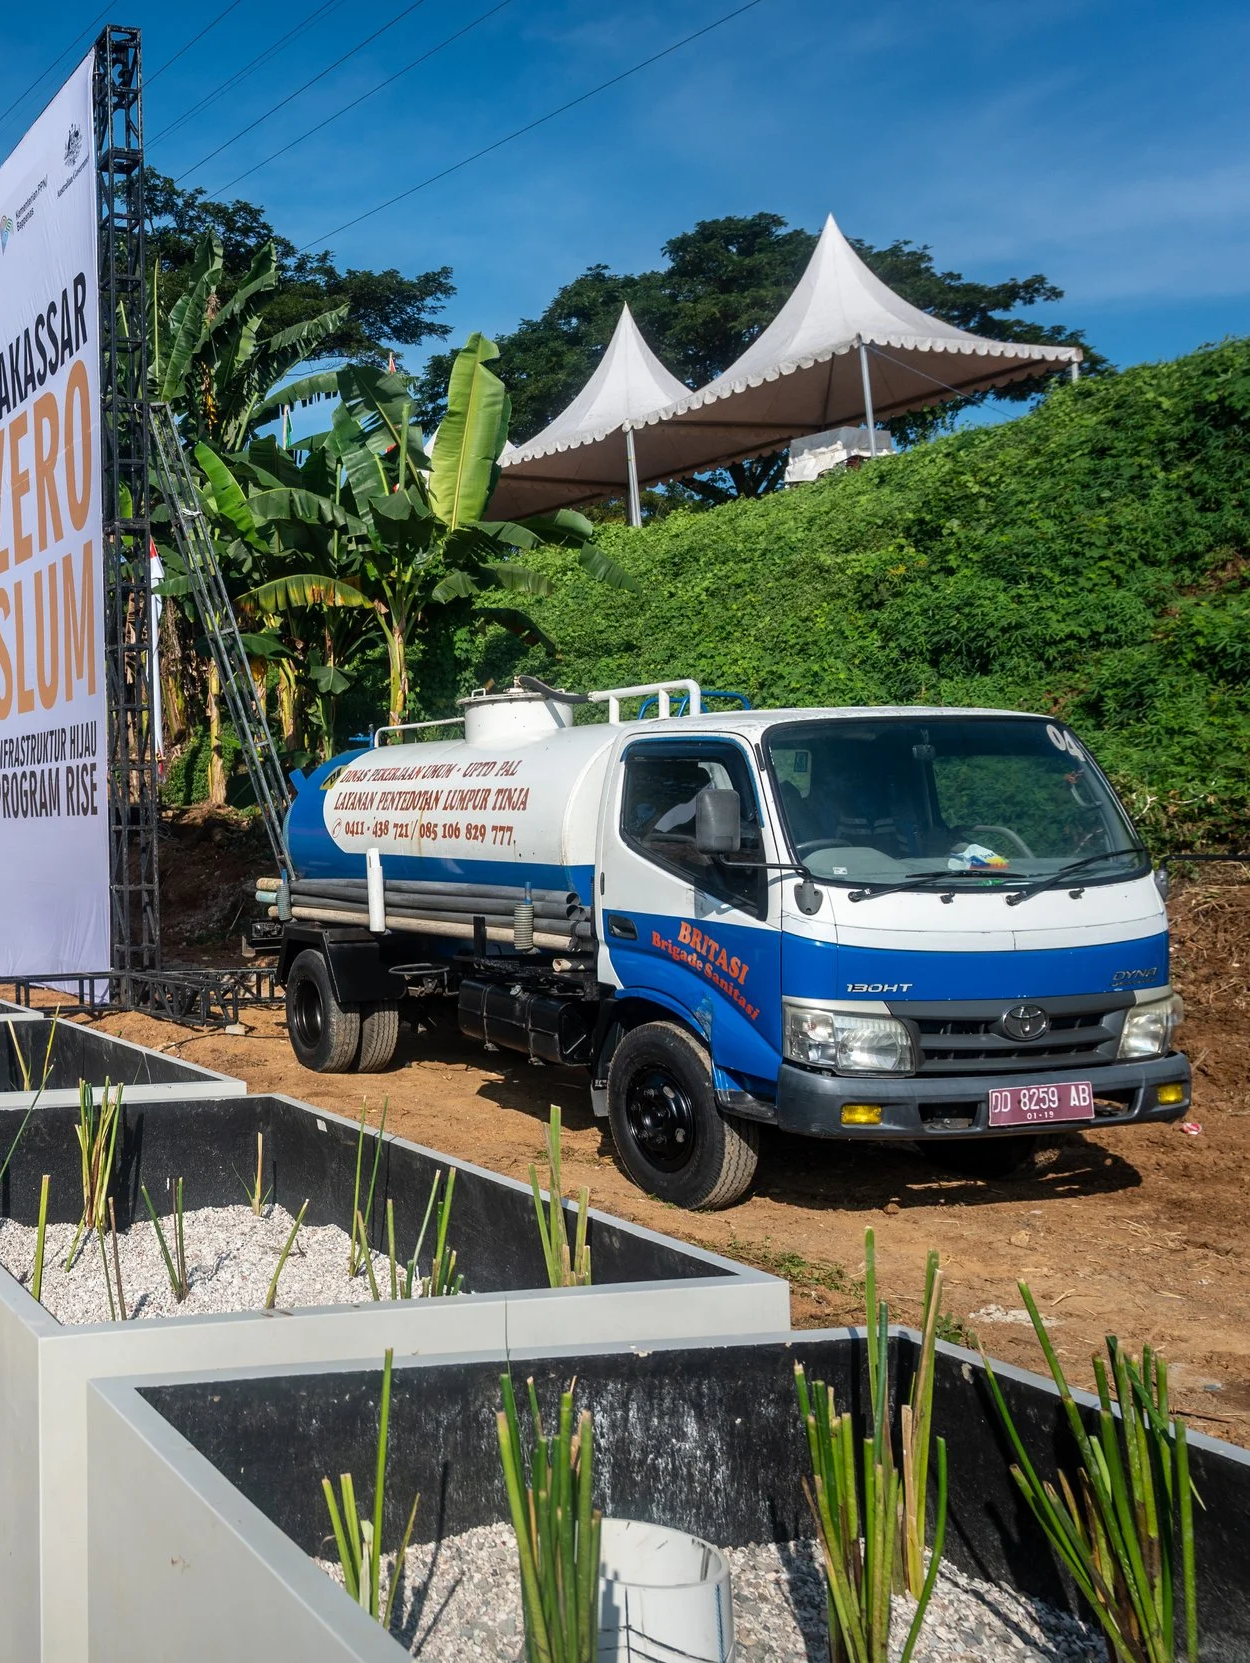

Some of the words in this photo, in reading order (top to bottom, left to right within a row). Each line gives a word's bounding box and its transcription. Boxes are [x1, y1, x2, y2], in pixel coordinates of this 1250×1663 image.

[16, 190, 38, 219] Kementerian
[69, 720, 97, 760] HIJAU
[1046, 724, 1086, 761] 04
[340, 768, 369, 783] DINAS
[367, 766, 424, 782] PEKERJAAN
[421, 763, 458, 779] UMUM
[462, 761, 497, 777] UPTD
[494, 760, 523, 776] PAL
[66, 762, 98, 817] RISE
[334, 791, 378, 810] LAYANAN
[376, 790, 444, 811] PENYEDOTAN
[442, 788, 491, 811] LUMPUR
[491, 787, 530, 811] TINJA
[345, 821, 365, 837] 0411
[372, 820, 389, 838] 438
[419, 822, 438, 841] 085
[441, 822, 461, 839] 106
[465, 823, 486, 843] 829
[491, 825, 513, 846] 777
[652, 930, 703, 971] Brigade
[677, 920, 749, 985] BRITASI
[846, 983, 913, 992] 130HT
[1113, 967, 1157, 980] DYNA
[704, 963, 761, 1020] Sanitasi
[992, 1091, 1011, 1112] DD
[1020, 1087, 1058, 1110] 8259
[1070, 1085, 1090, 1107] AB
